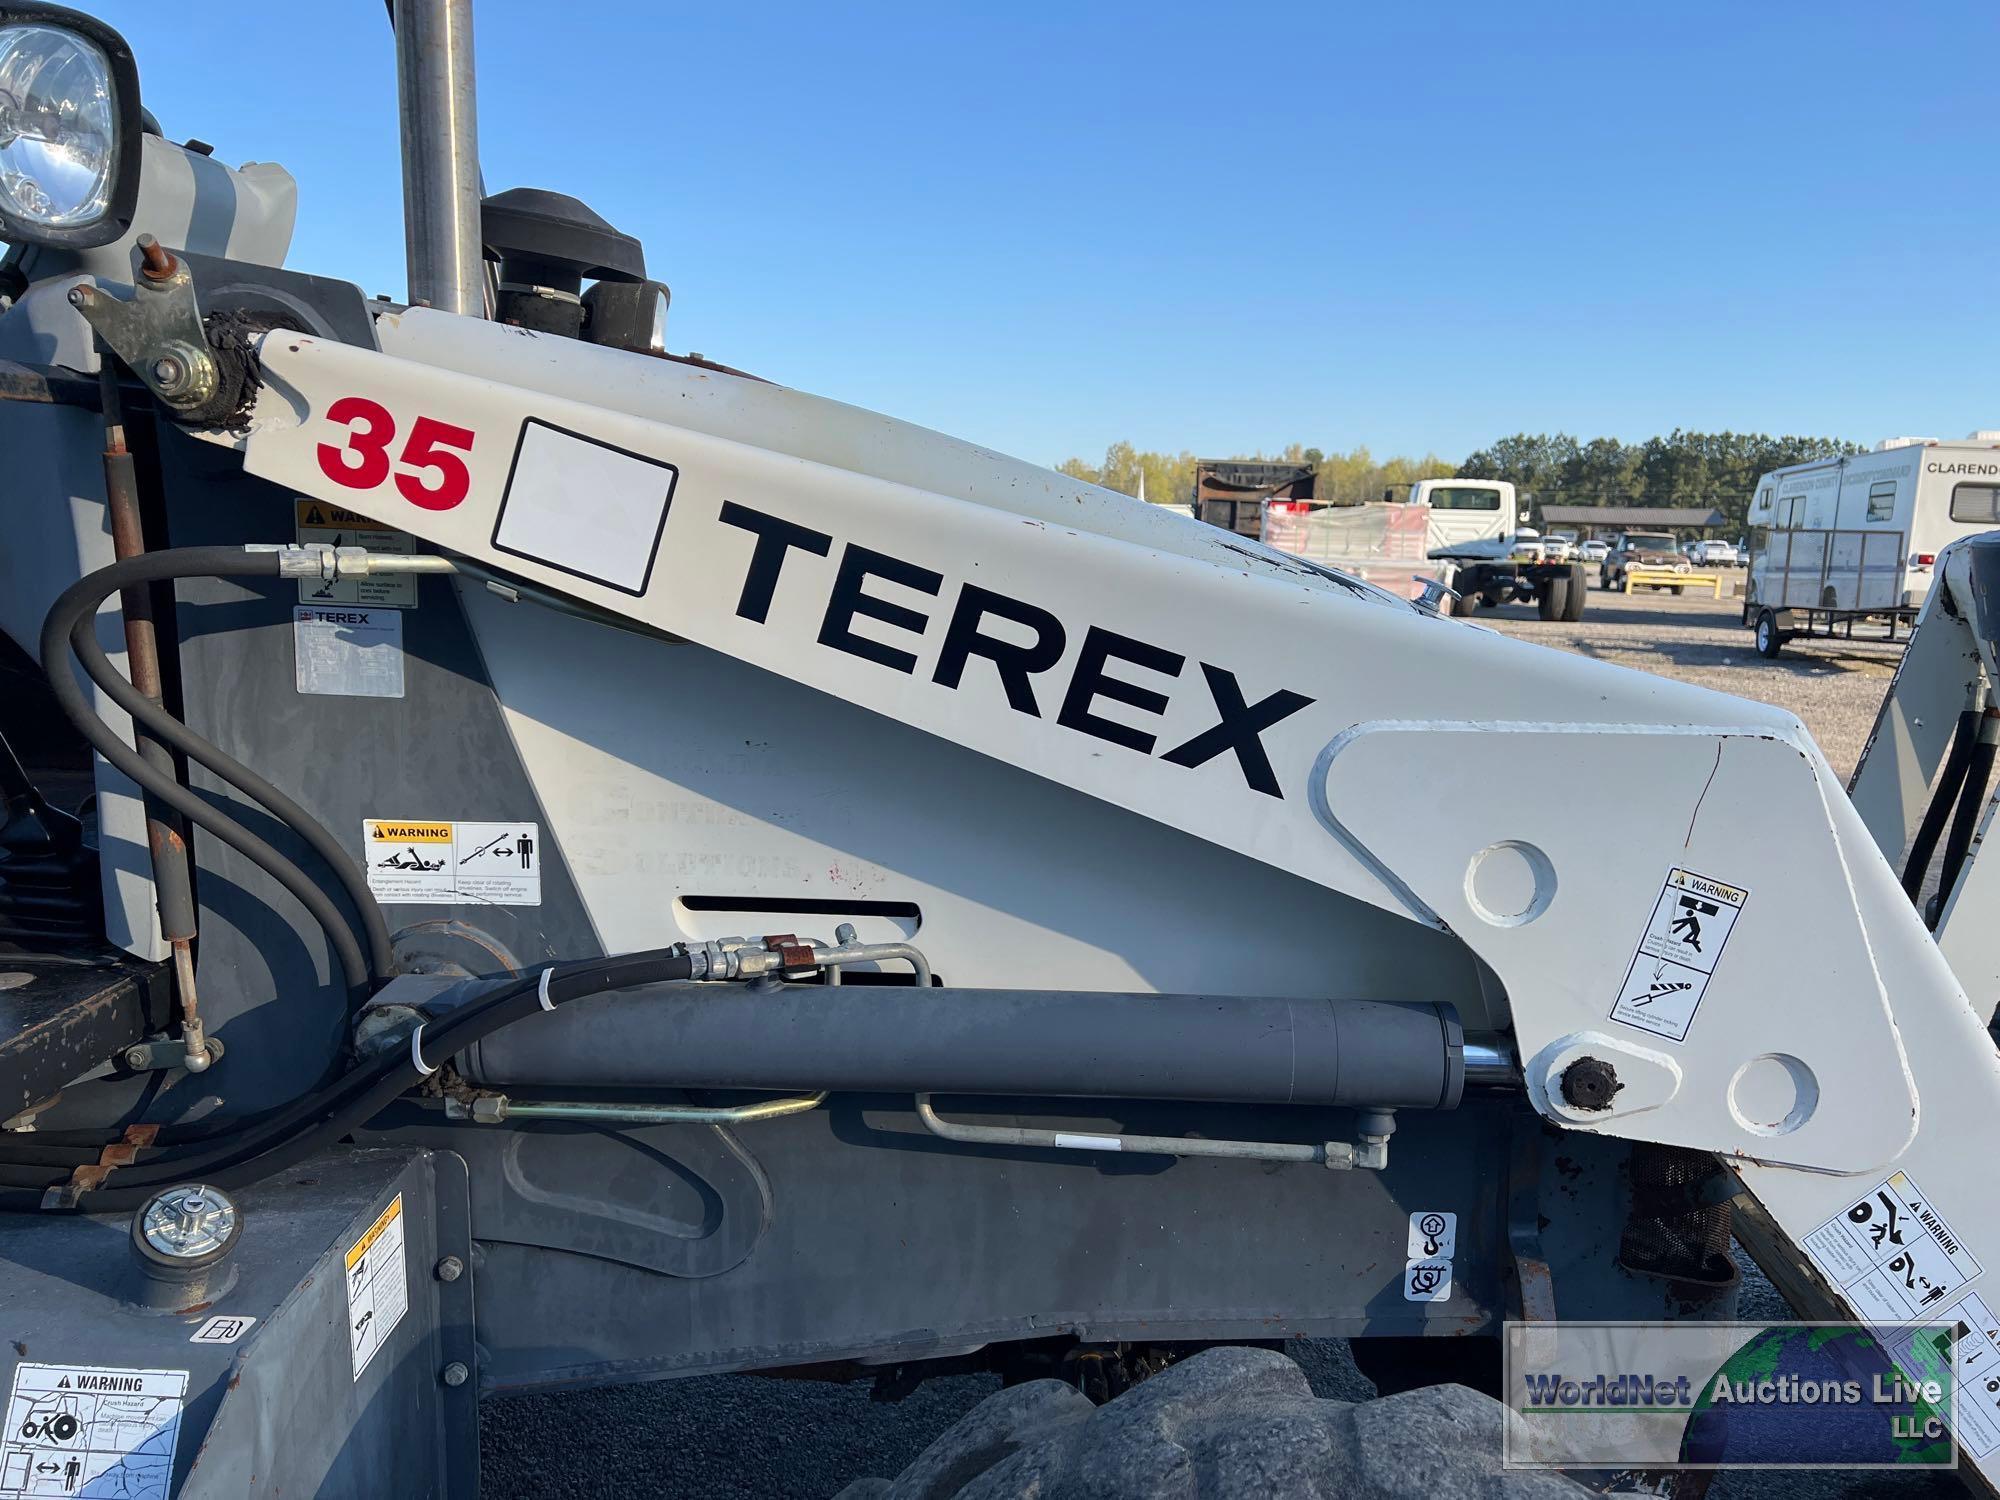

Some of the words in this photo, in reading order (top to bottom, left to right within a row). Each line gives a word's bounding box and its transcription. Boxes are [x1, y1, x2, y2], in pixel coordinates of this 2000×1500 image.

[318, 398, 474, 510] 35
[1927, 462, 2000, 475] CLAREND
[315, 611, 370, 624] TEREX
[719, 500, 1316, 800] TEREX
[387, 828, 449, 837] WARNING
[1691, 879, 1739, 903] WARNING
[1920, 1210, 1959, 1256] WARNING
[77, 1375, 143, 1392] WARNING
